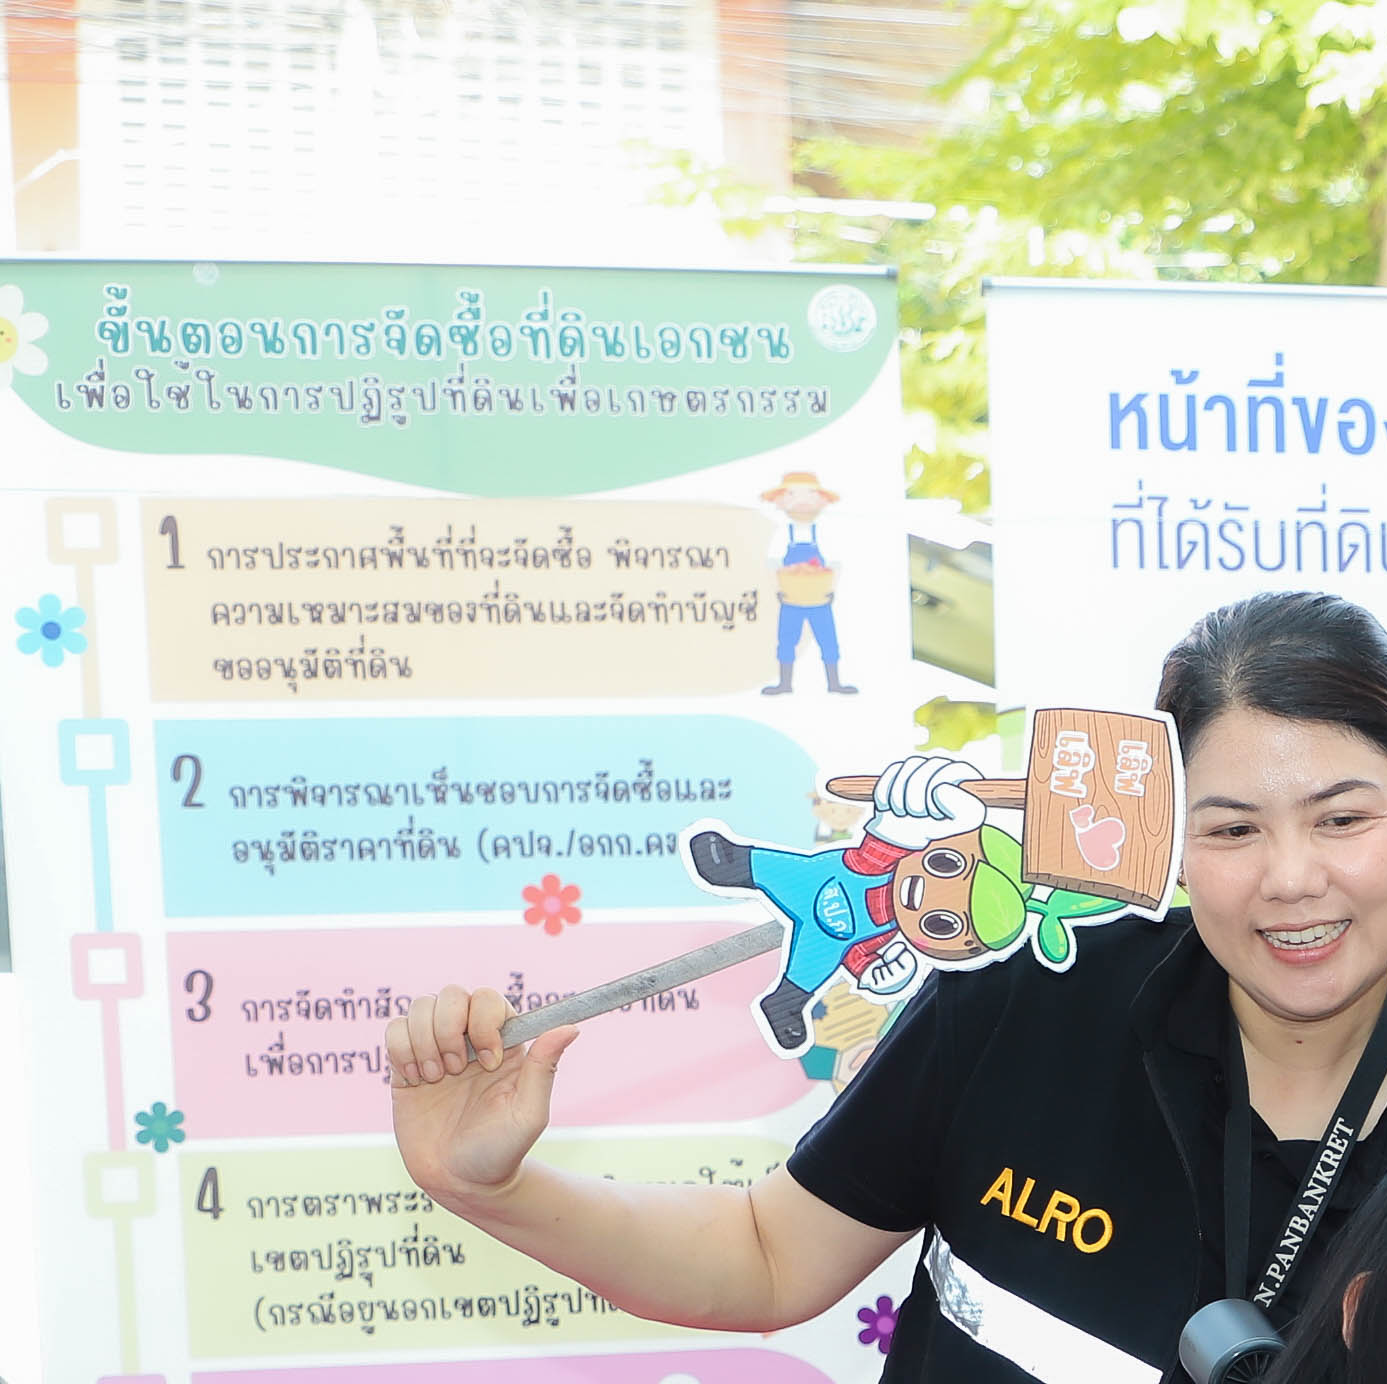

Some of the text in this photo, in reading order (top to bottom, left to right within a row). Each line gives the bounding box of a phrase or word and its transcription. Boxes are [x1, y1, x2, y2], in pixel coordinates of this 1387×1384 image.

[97, 285, 791, 358] ขั้นตอนการจัดซื้อที่ดินเอกชน
[56, 358, 828, 424] เพื่อใช้ในการปฏิรูปที่ดินเพื่อเกษตรกรรม
[160, 514, 731, 572] 1 การประกาศพื้นที่ที่จะจัดซื้อ พิจารณา
[211, 582, 759, 631] ความเหมาะสมของที่ดินและจัดทำบัญชี
[213, 637, 414, 692] ขออนุมัติที่ดิน
[172, 754, 733, 812] 2 การพิจารณาเห็นชอบการจัดซื้อและ
[232, 825, 678, 876] อนุมัติราคาที่ดิน (คปจ./อกก.คง
[185, 970, 215, 1024] 3
[245, 1032, 391, 1083] เพื่อการป
[196, 1166, 434, 1220] 4 การตราพระร
[980, 1167, 1115, 1255] ALRO
[1253, 1116, 1355, 1309] N.PANBANKRET
[250, 1223, 466, 1280] เขตปฏิรูปที่ดิน
